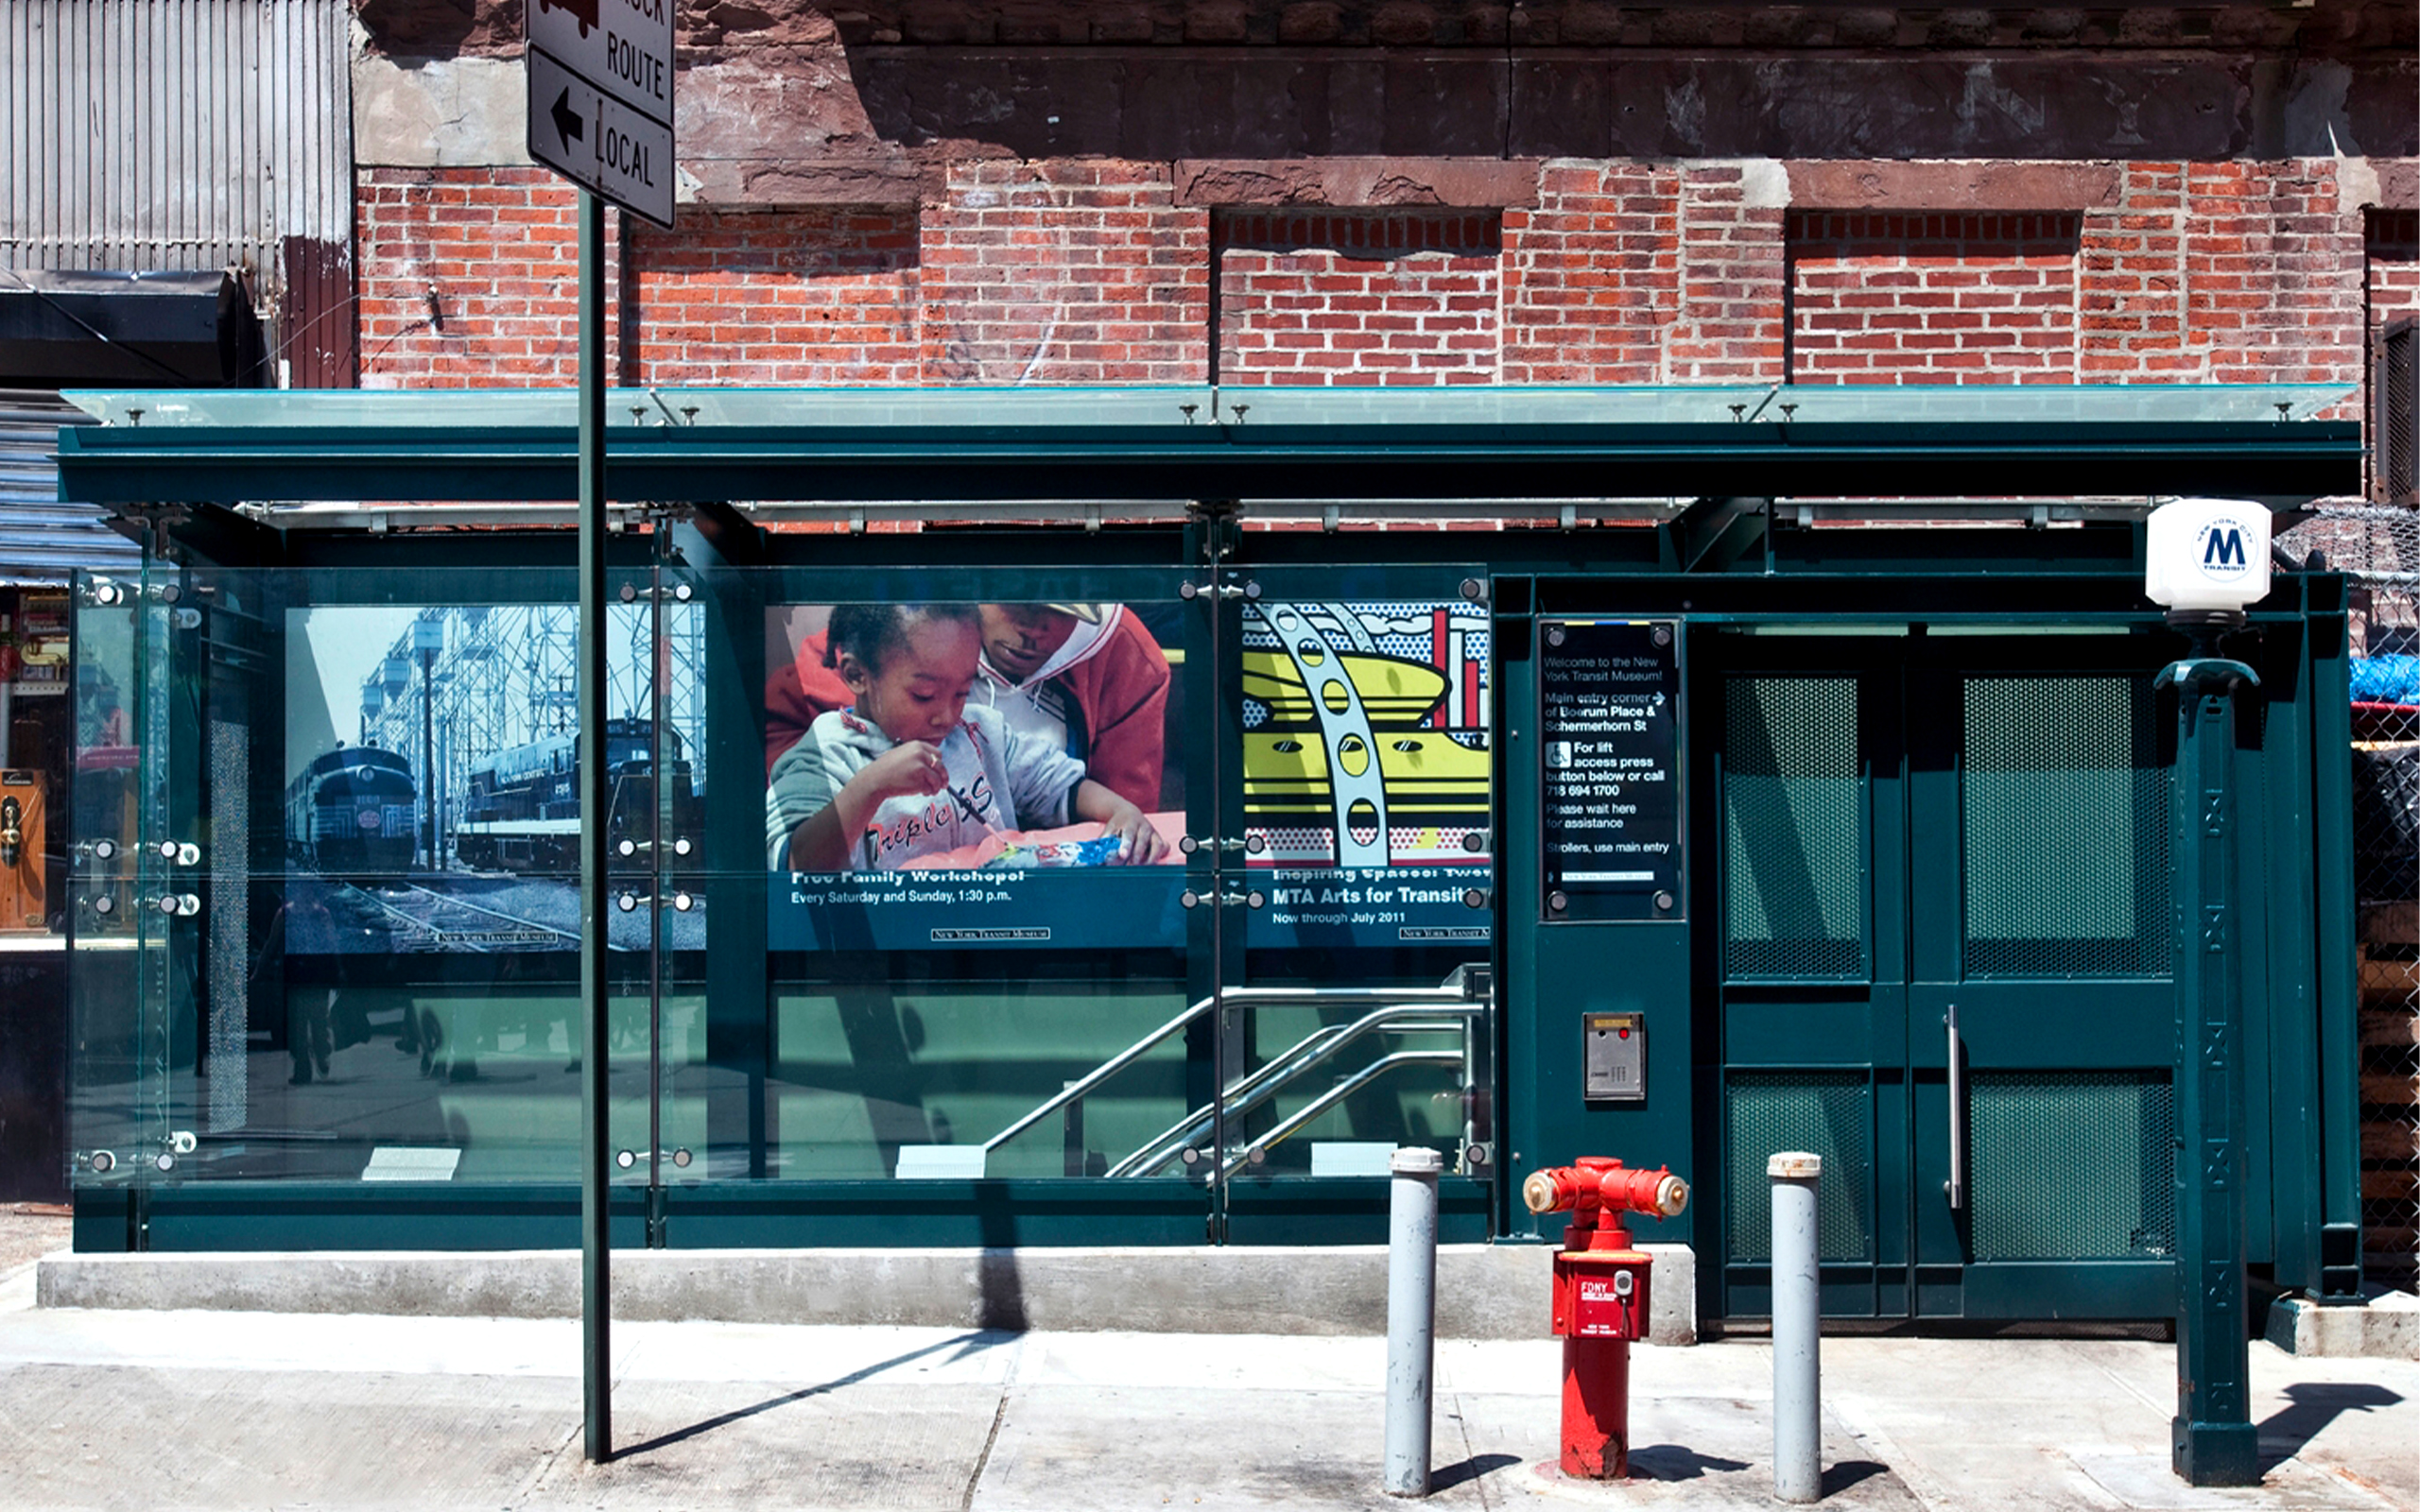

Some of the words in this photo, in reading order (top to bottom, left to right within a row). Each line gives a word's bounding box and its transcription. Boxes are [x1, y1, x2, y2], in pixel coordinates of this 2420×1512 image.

[607, 29, 664, 101] ROUTE
[596, 119, 654, 188] LOCAL
[2239, 524, 2254, 543] CITY
[2204, 528, 2246, 565] M
[1544, 657, 1596, 668] Welcome
[1598, 658, 1610, 668] to
[1612, 657, 1631, 668] the
[1633, 658, 1659, 668] New
[1545, 670, 1570, 681] York
[1572, 670, 1609, 681] Transit
[1611, 670, 1663, 681] Museum!
[1545, 692, 1575, 704] Main
[1577, 693, 1608, 706] entry
[1611, 693, 1651, 704] corner
[1545, 707, 1558, 717] of
[1610, 705, 1645, 717] Place
[1646, 706, 1656, 717] &
[1545, 720, 1632, 731] Schermerhorn
[1634, 719, 1648, 731] St
[1573, 742, 1595, 754] For
[1597, 741, 1614, 754] lift
[1573, 757, 1617, 768] access
[1619, 758, 1654, 769] press
[1546, 770, 1586, 782] button
[1588, 770, 1625, 782] below
[1627, 771, 1642, 782] or
[1643, 769, 1666, 782] call
[1546, 784, 1566, 797] 718
[1568, 784, 1591, 797] 694
[1593, 784, 1620, 797] 1700
[1547, 803, 1584, 815] Please
[1586, 803, 1610, 815] wait
[1612, 803, 1637, 815] here
[1547, 817, 1563, 829] for
[1564, 816, 1624, 829] assistance
[864, 803, 952, 862] Triple
[1547, 841, 1593, 854] Strollers,
[1594, 844, 1614, 853] use
[1615, 841, 1641, 853] main
[1643, 842, 1670, 855] entry
[790, 891, 825, 906] Every
[827, 890, 881, 905] Saturday
[883, 889, 907, 902] and
[908, 888, 956, 905] Sunday,
[959, 889, 983, 902] 1:30
[986, 891, 1012, 904] p.m.
[1272, 887, 1315, 905] MTA
[1320, 887, 1361, 904] Arts
[1365, 886, 1393, 903] for
[1397, 886, 1464, 903] Transit
[1272, 912, 1299, 924] Now
[1301, 912, 1349, 926] through
[1351, 911, 1376, 925] July
[1377, 911, 1406, 923] 2011
[979, 930, 1011, 938] TRANSIT
[1403, 928, 1422, 937] NEW
[1424, 928, 1445, 937] YORK
[1447, 928, 1480, 937] TRANSIT
